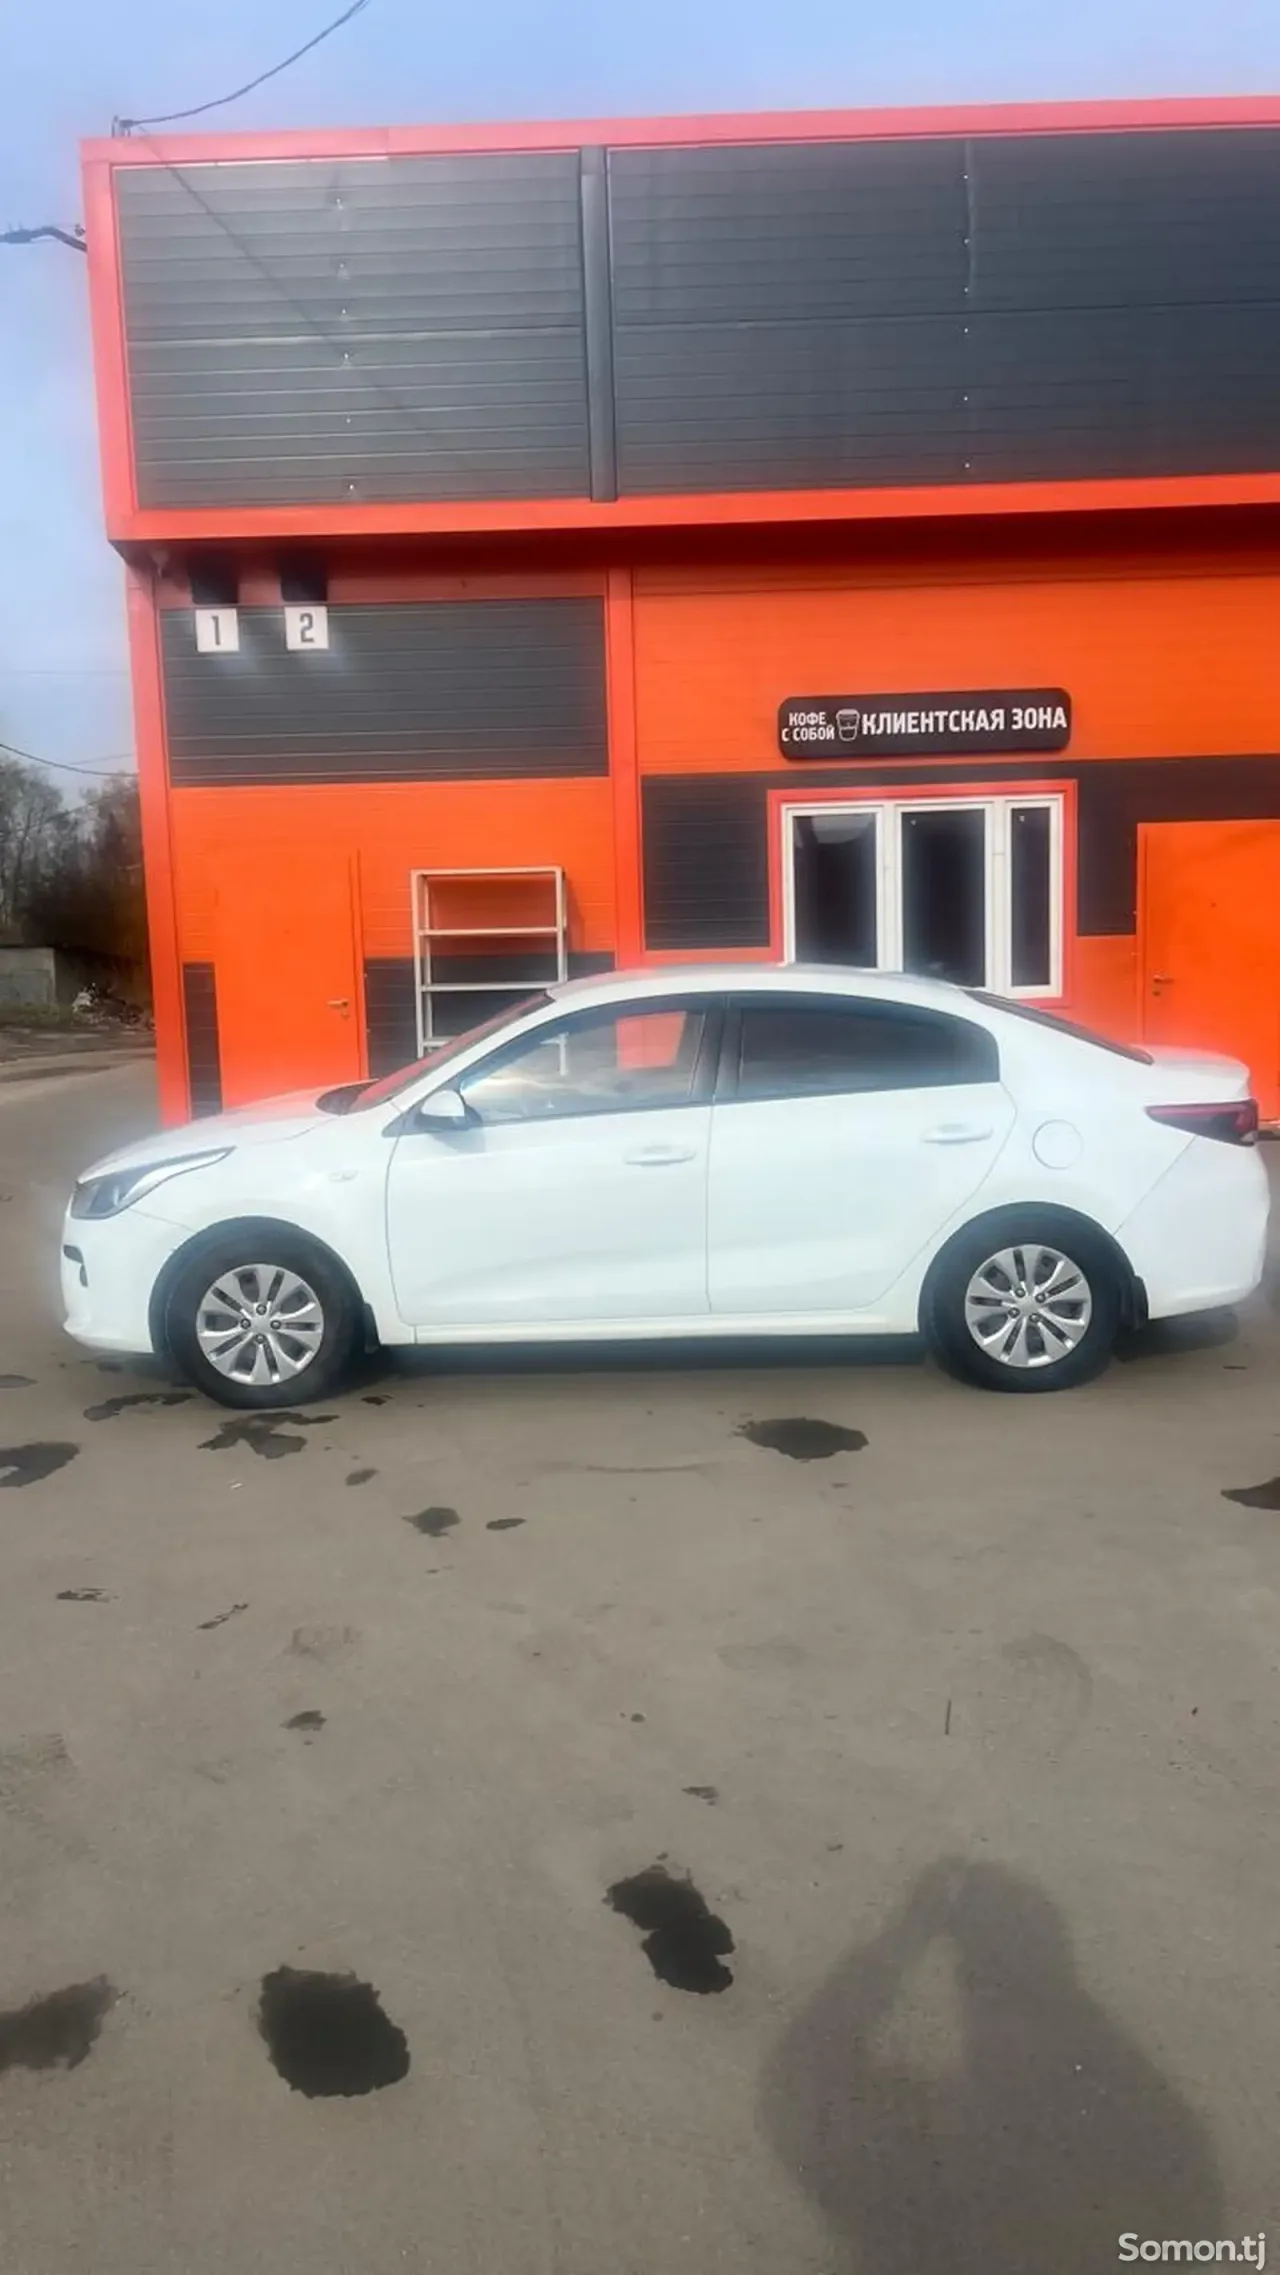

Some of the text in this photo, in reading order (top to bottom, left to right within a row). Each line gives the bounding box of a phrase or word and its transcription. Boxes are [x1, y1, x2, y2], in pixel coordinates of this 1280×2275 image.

[210, 614, 221, 646] 1
[299, 612, 315, 643] 2
[781, 725, 836, 742] С СОБОЙ
[788, 711, 827, 727] КОФЕ
[861, 706, 1068, 736] КЛИЕНТСКАЯ ЗОНА
